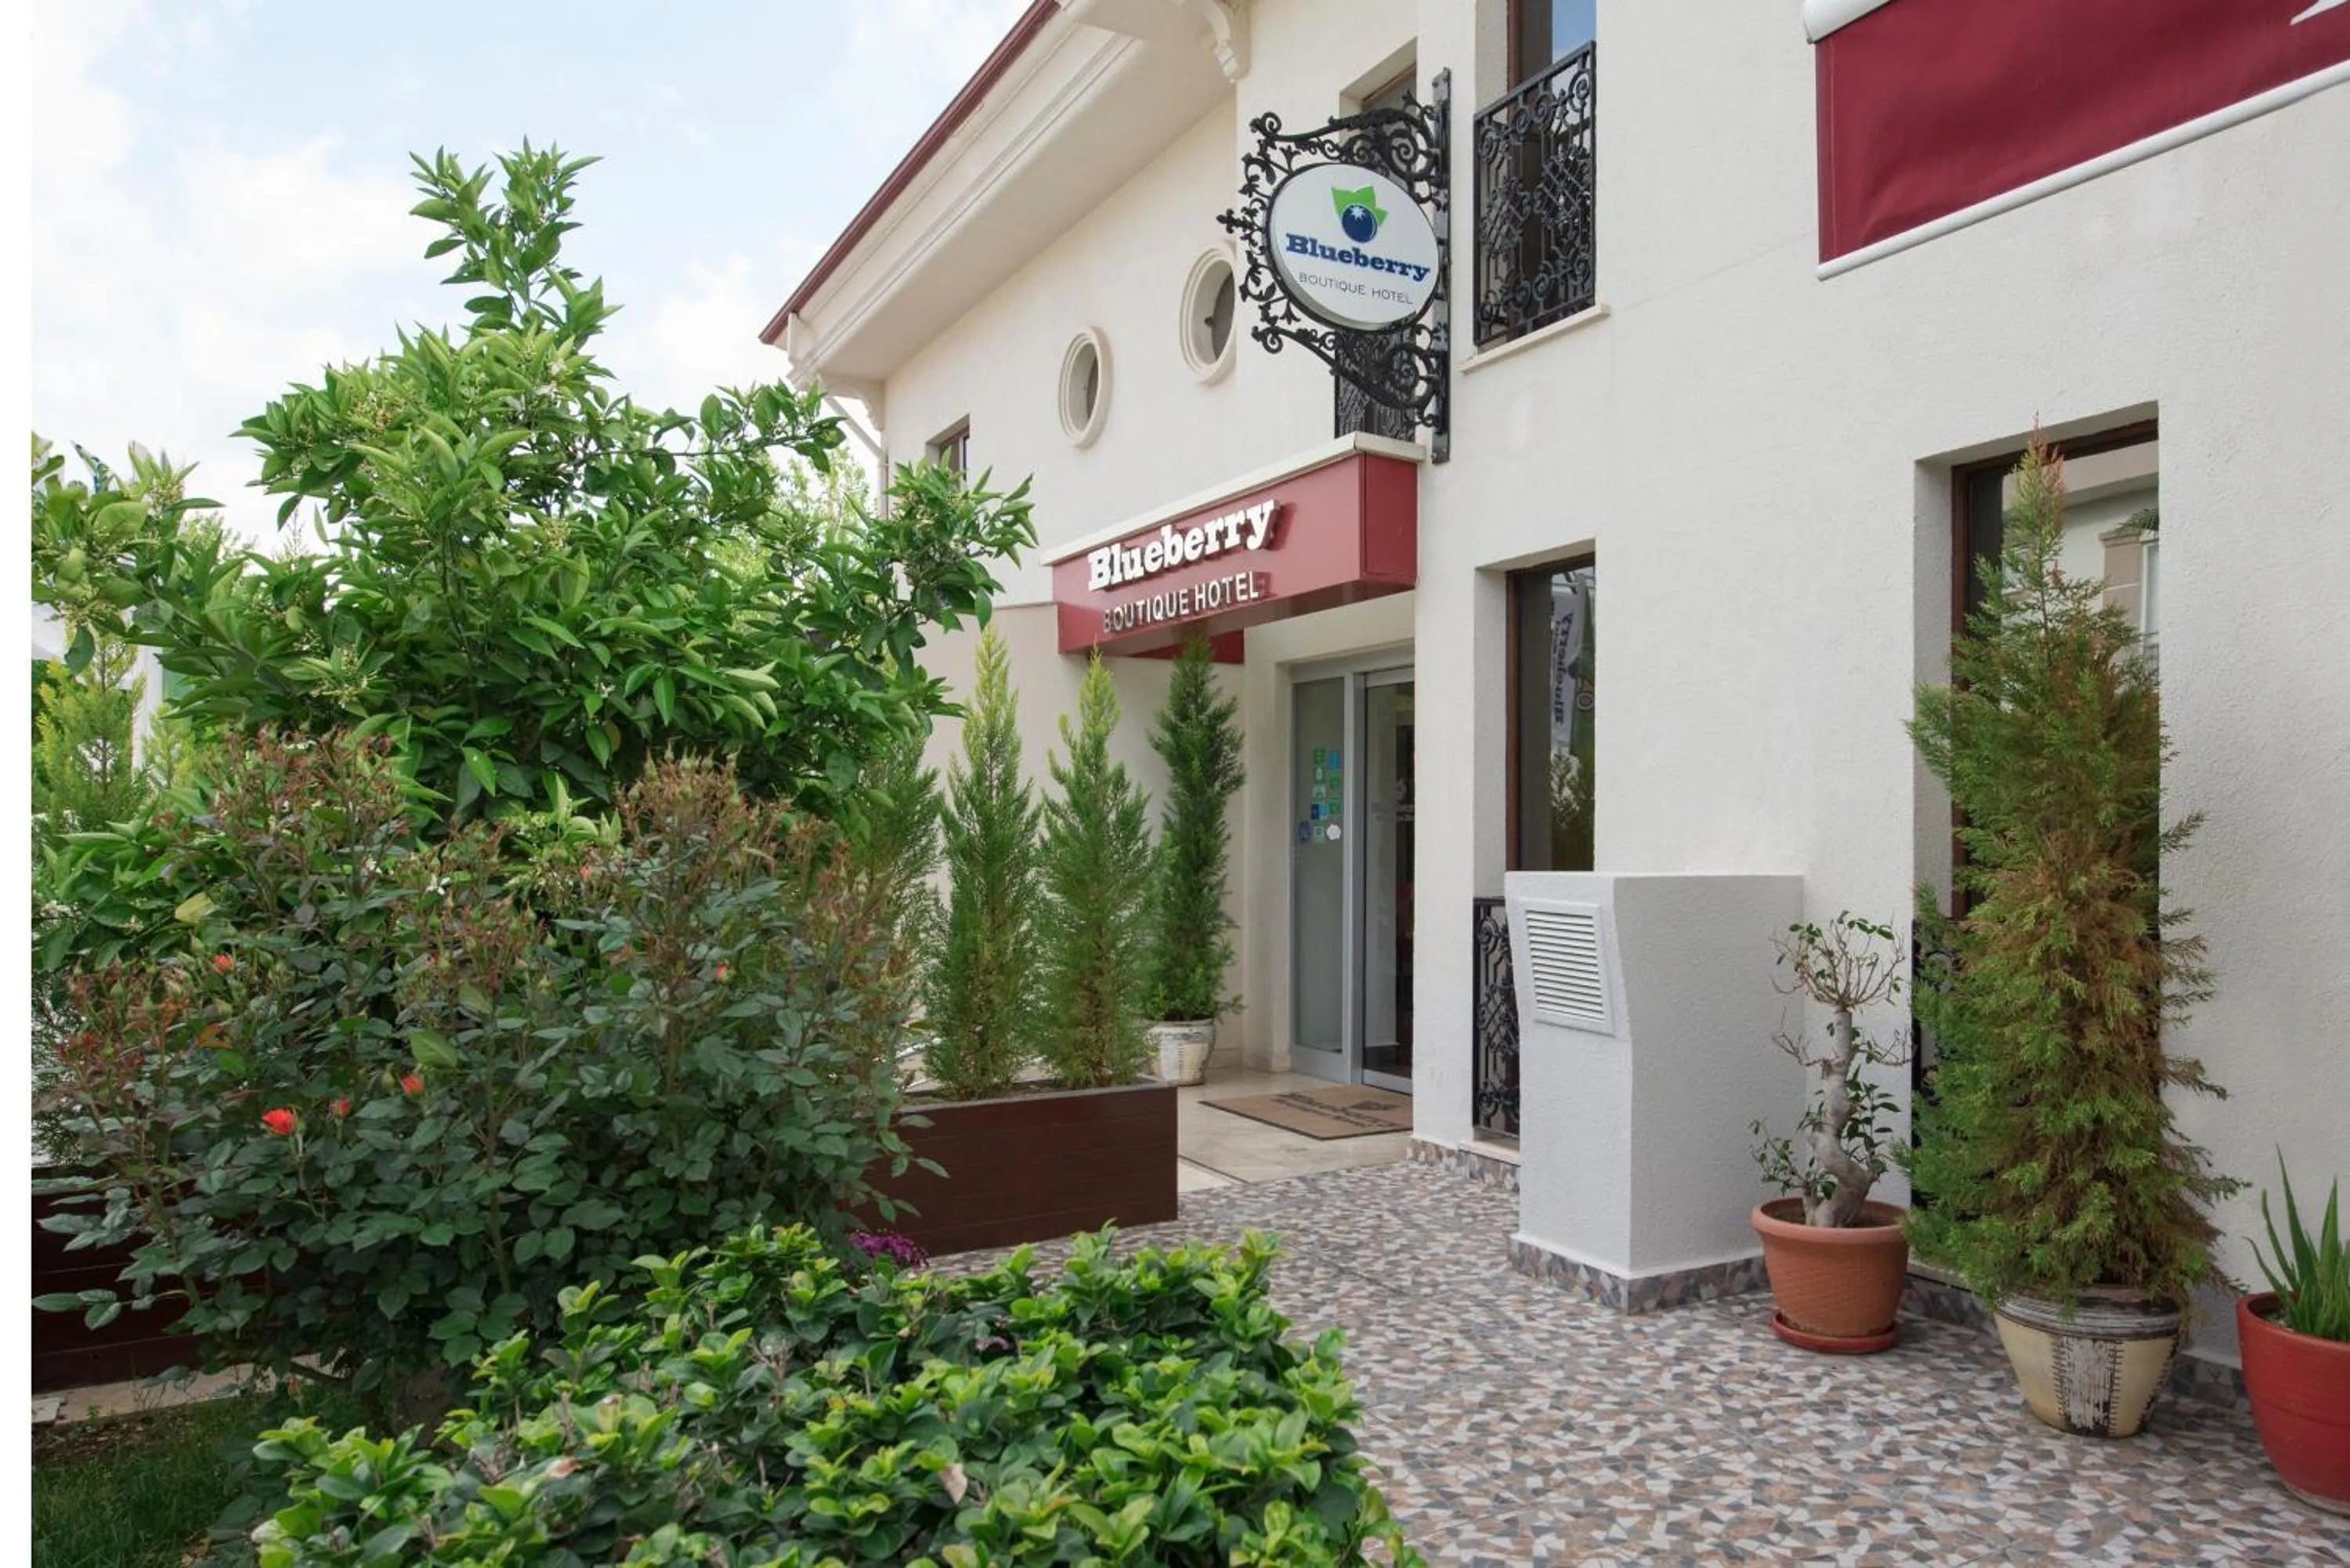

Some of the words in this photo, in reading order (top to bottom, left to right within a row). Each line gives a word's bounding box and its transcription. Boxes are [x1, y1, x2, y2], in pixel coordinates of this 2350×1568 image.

[1285, 233, 1431, 282] Blueberry
[1298, 272, 1365, 295] BOUTIQUE
[1372, 287, 1413, 305] HOTEL
[1087, 499, 1277, 592] Blueberry
[1102, 587, 1189, 633] BOUTIQUE
[1195, 569, 1260, 612] HOTEL
